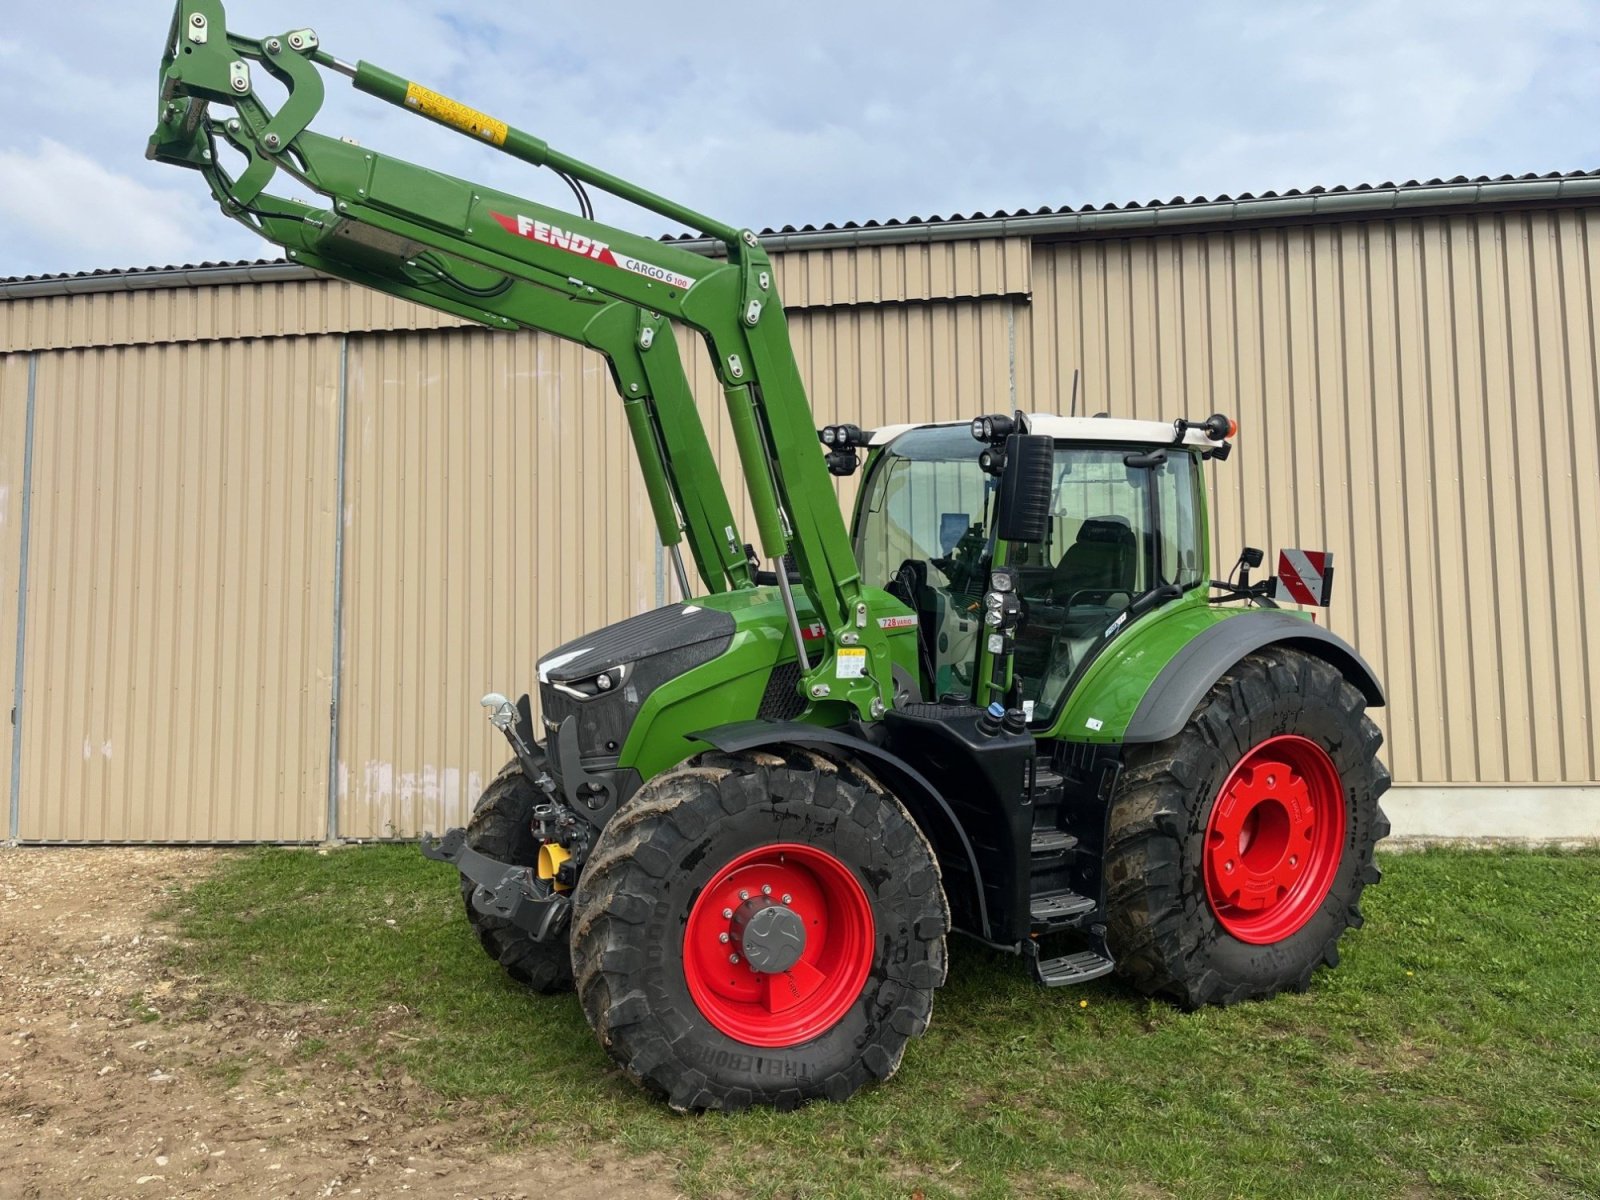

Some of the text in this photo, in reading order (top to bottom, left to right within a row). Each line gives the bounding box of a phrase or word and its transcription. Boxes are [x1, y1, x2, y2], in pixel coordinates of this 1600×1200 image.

[517, 214, 687, 288] FENDT CARGO 6 100
[882, 617, 912, 627] 728 VARIO
